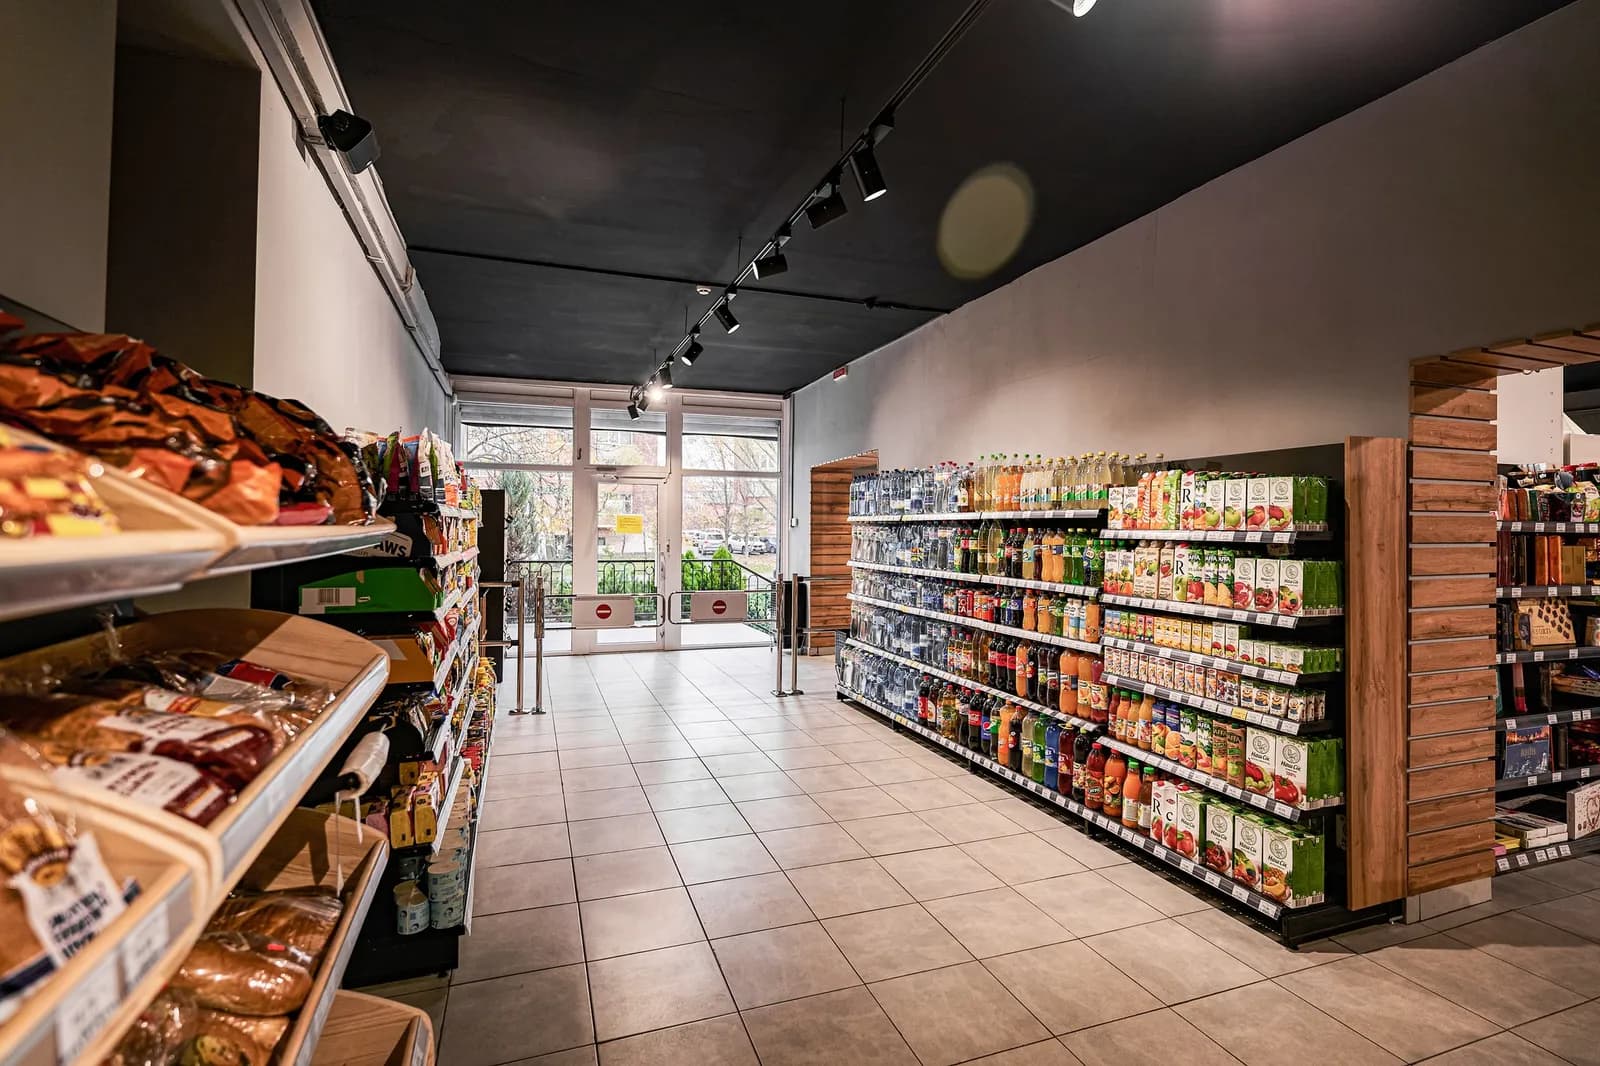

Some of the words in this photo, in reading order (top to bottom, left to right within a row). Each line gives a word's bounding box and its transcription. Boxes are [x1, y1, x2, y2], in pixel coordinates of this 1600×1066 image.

[1182, 488, 1191, 503] R
[1175, 560, 1185, 575] R
[1152, 797, 1162, 816] R
